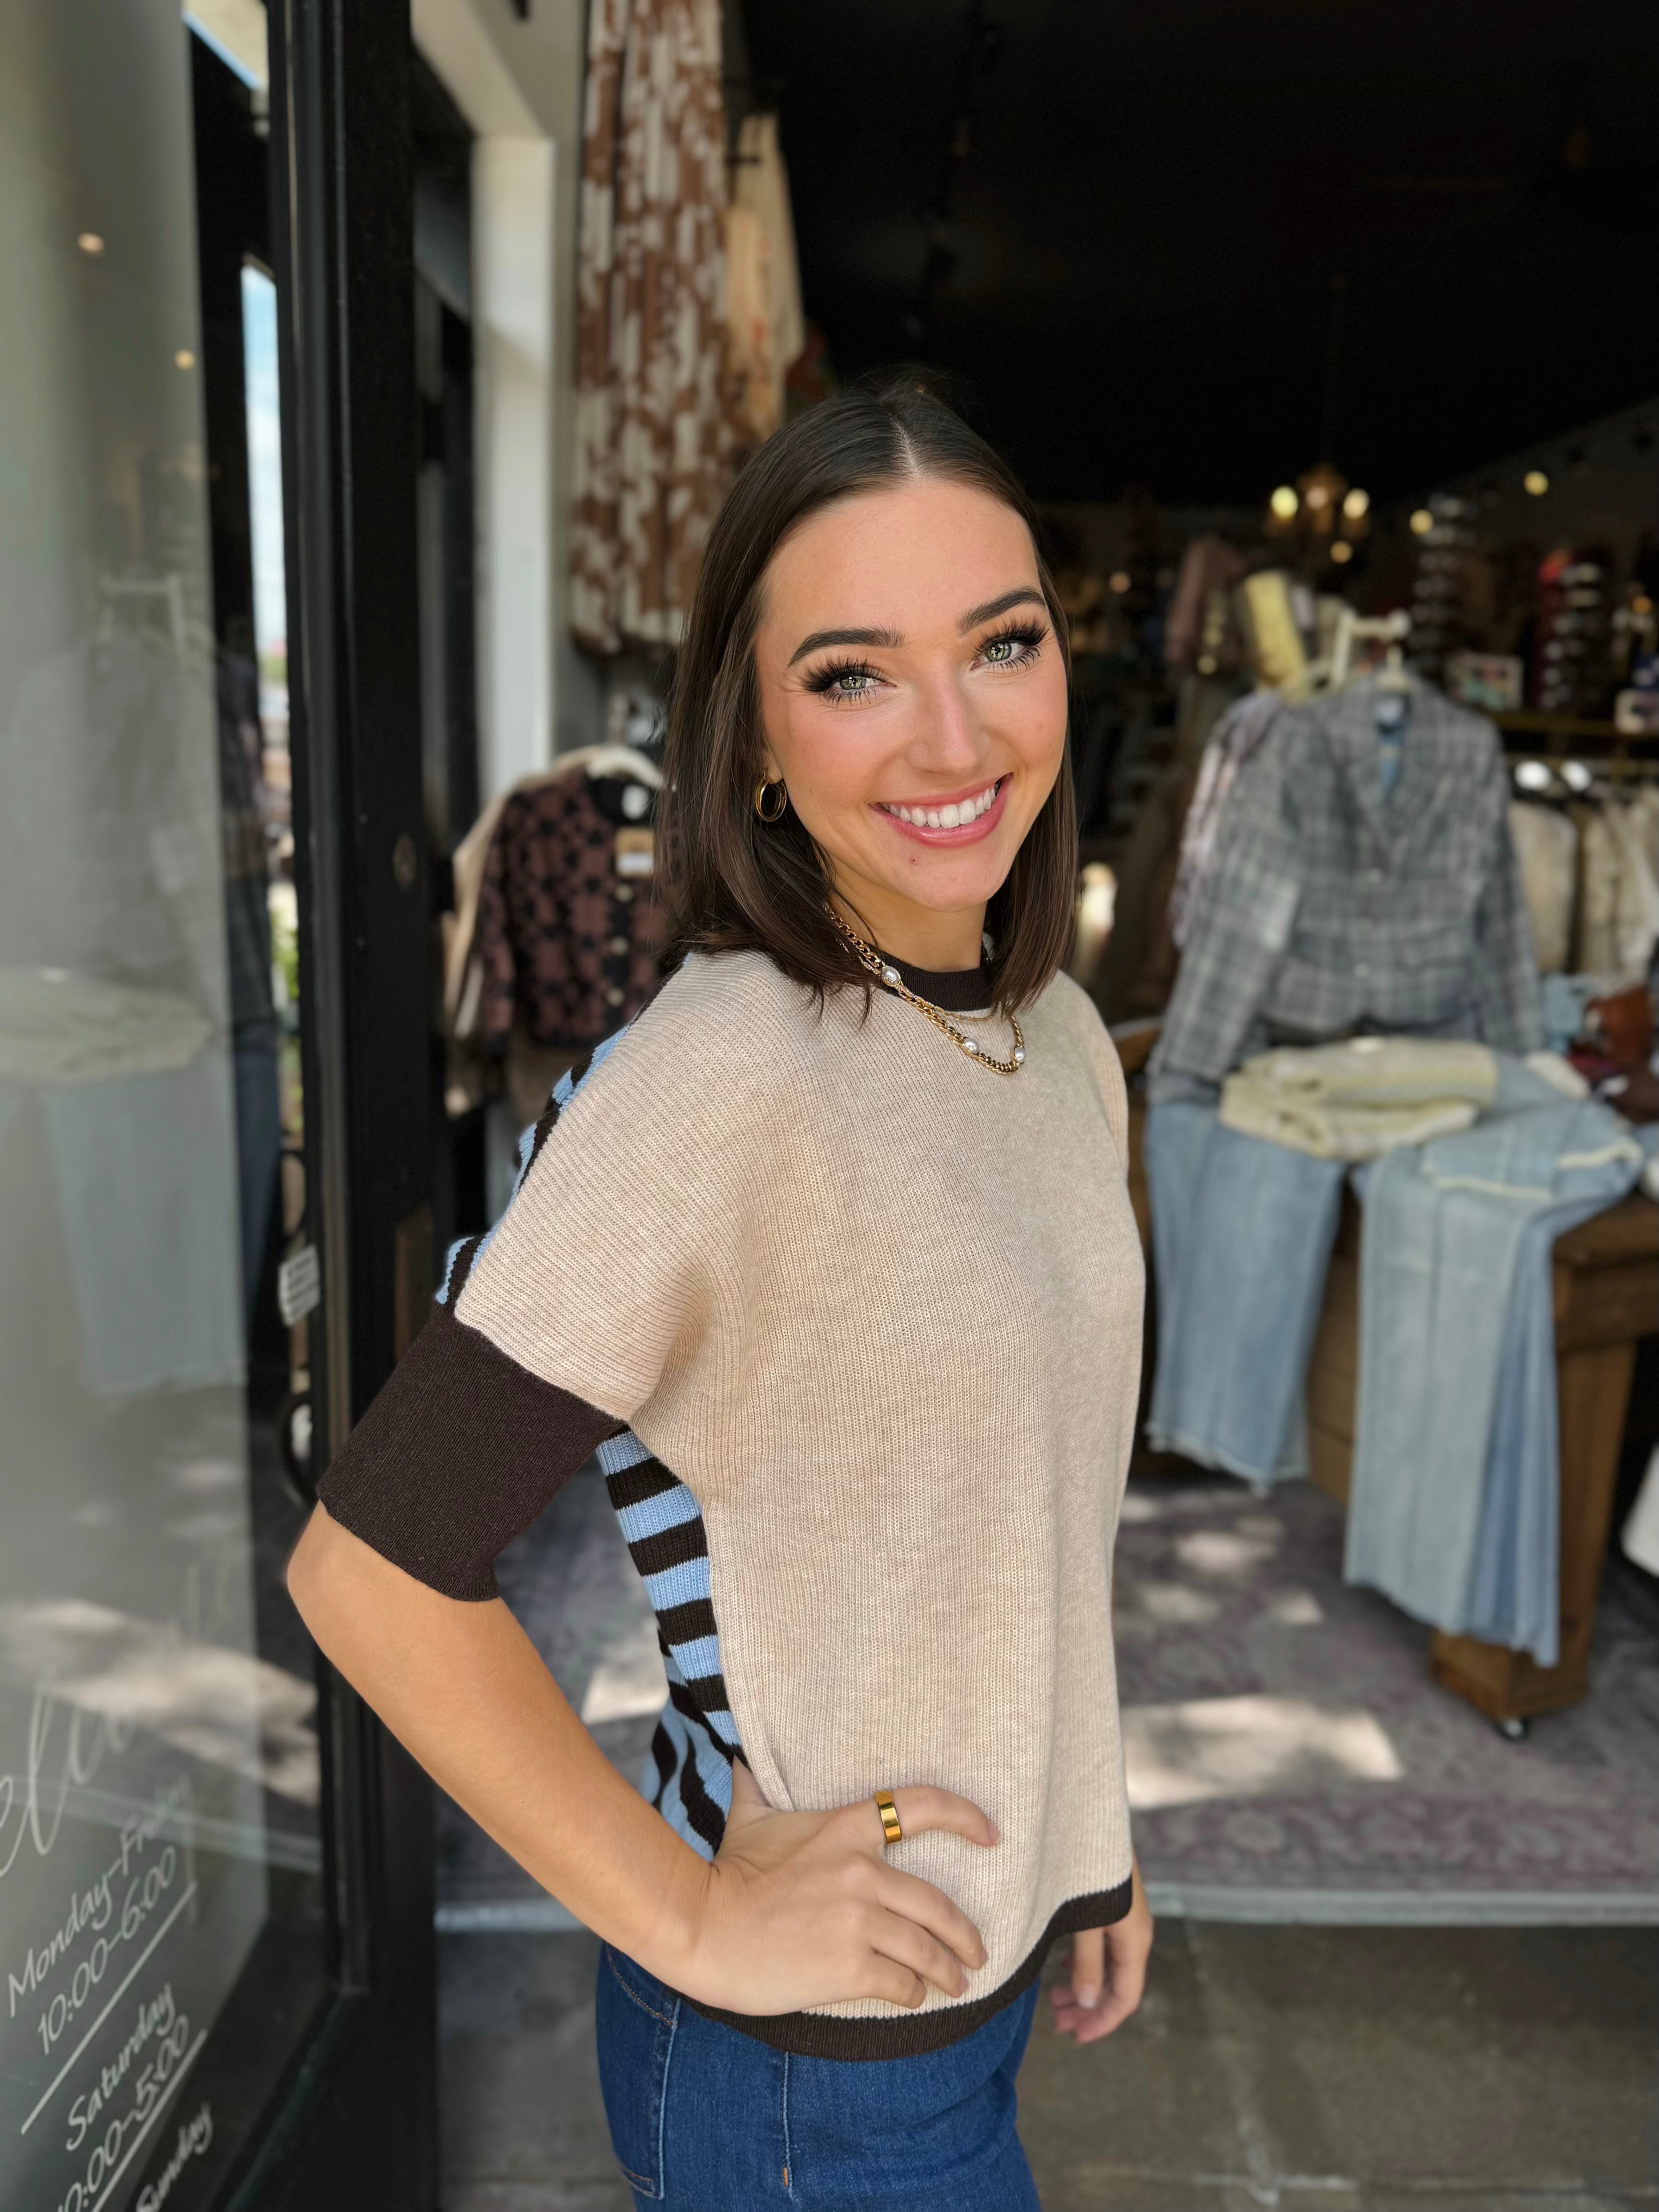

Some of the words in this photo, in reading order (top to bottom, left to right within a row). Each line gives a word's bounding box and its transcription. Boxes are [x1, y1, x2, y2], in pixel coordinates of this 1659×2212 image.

[37, 1846, 177, 2056] 10:00-6:00
[57, 2013, 190, 2212] 0:00-5:00
[65, 1981, 177, 2152] Saturday
